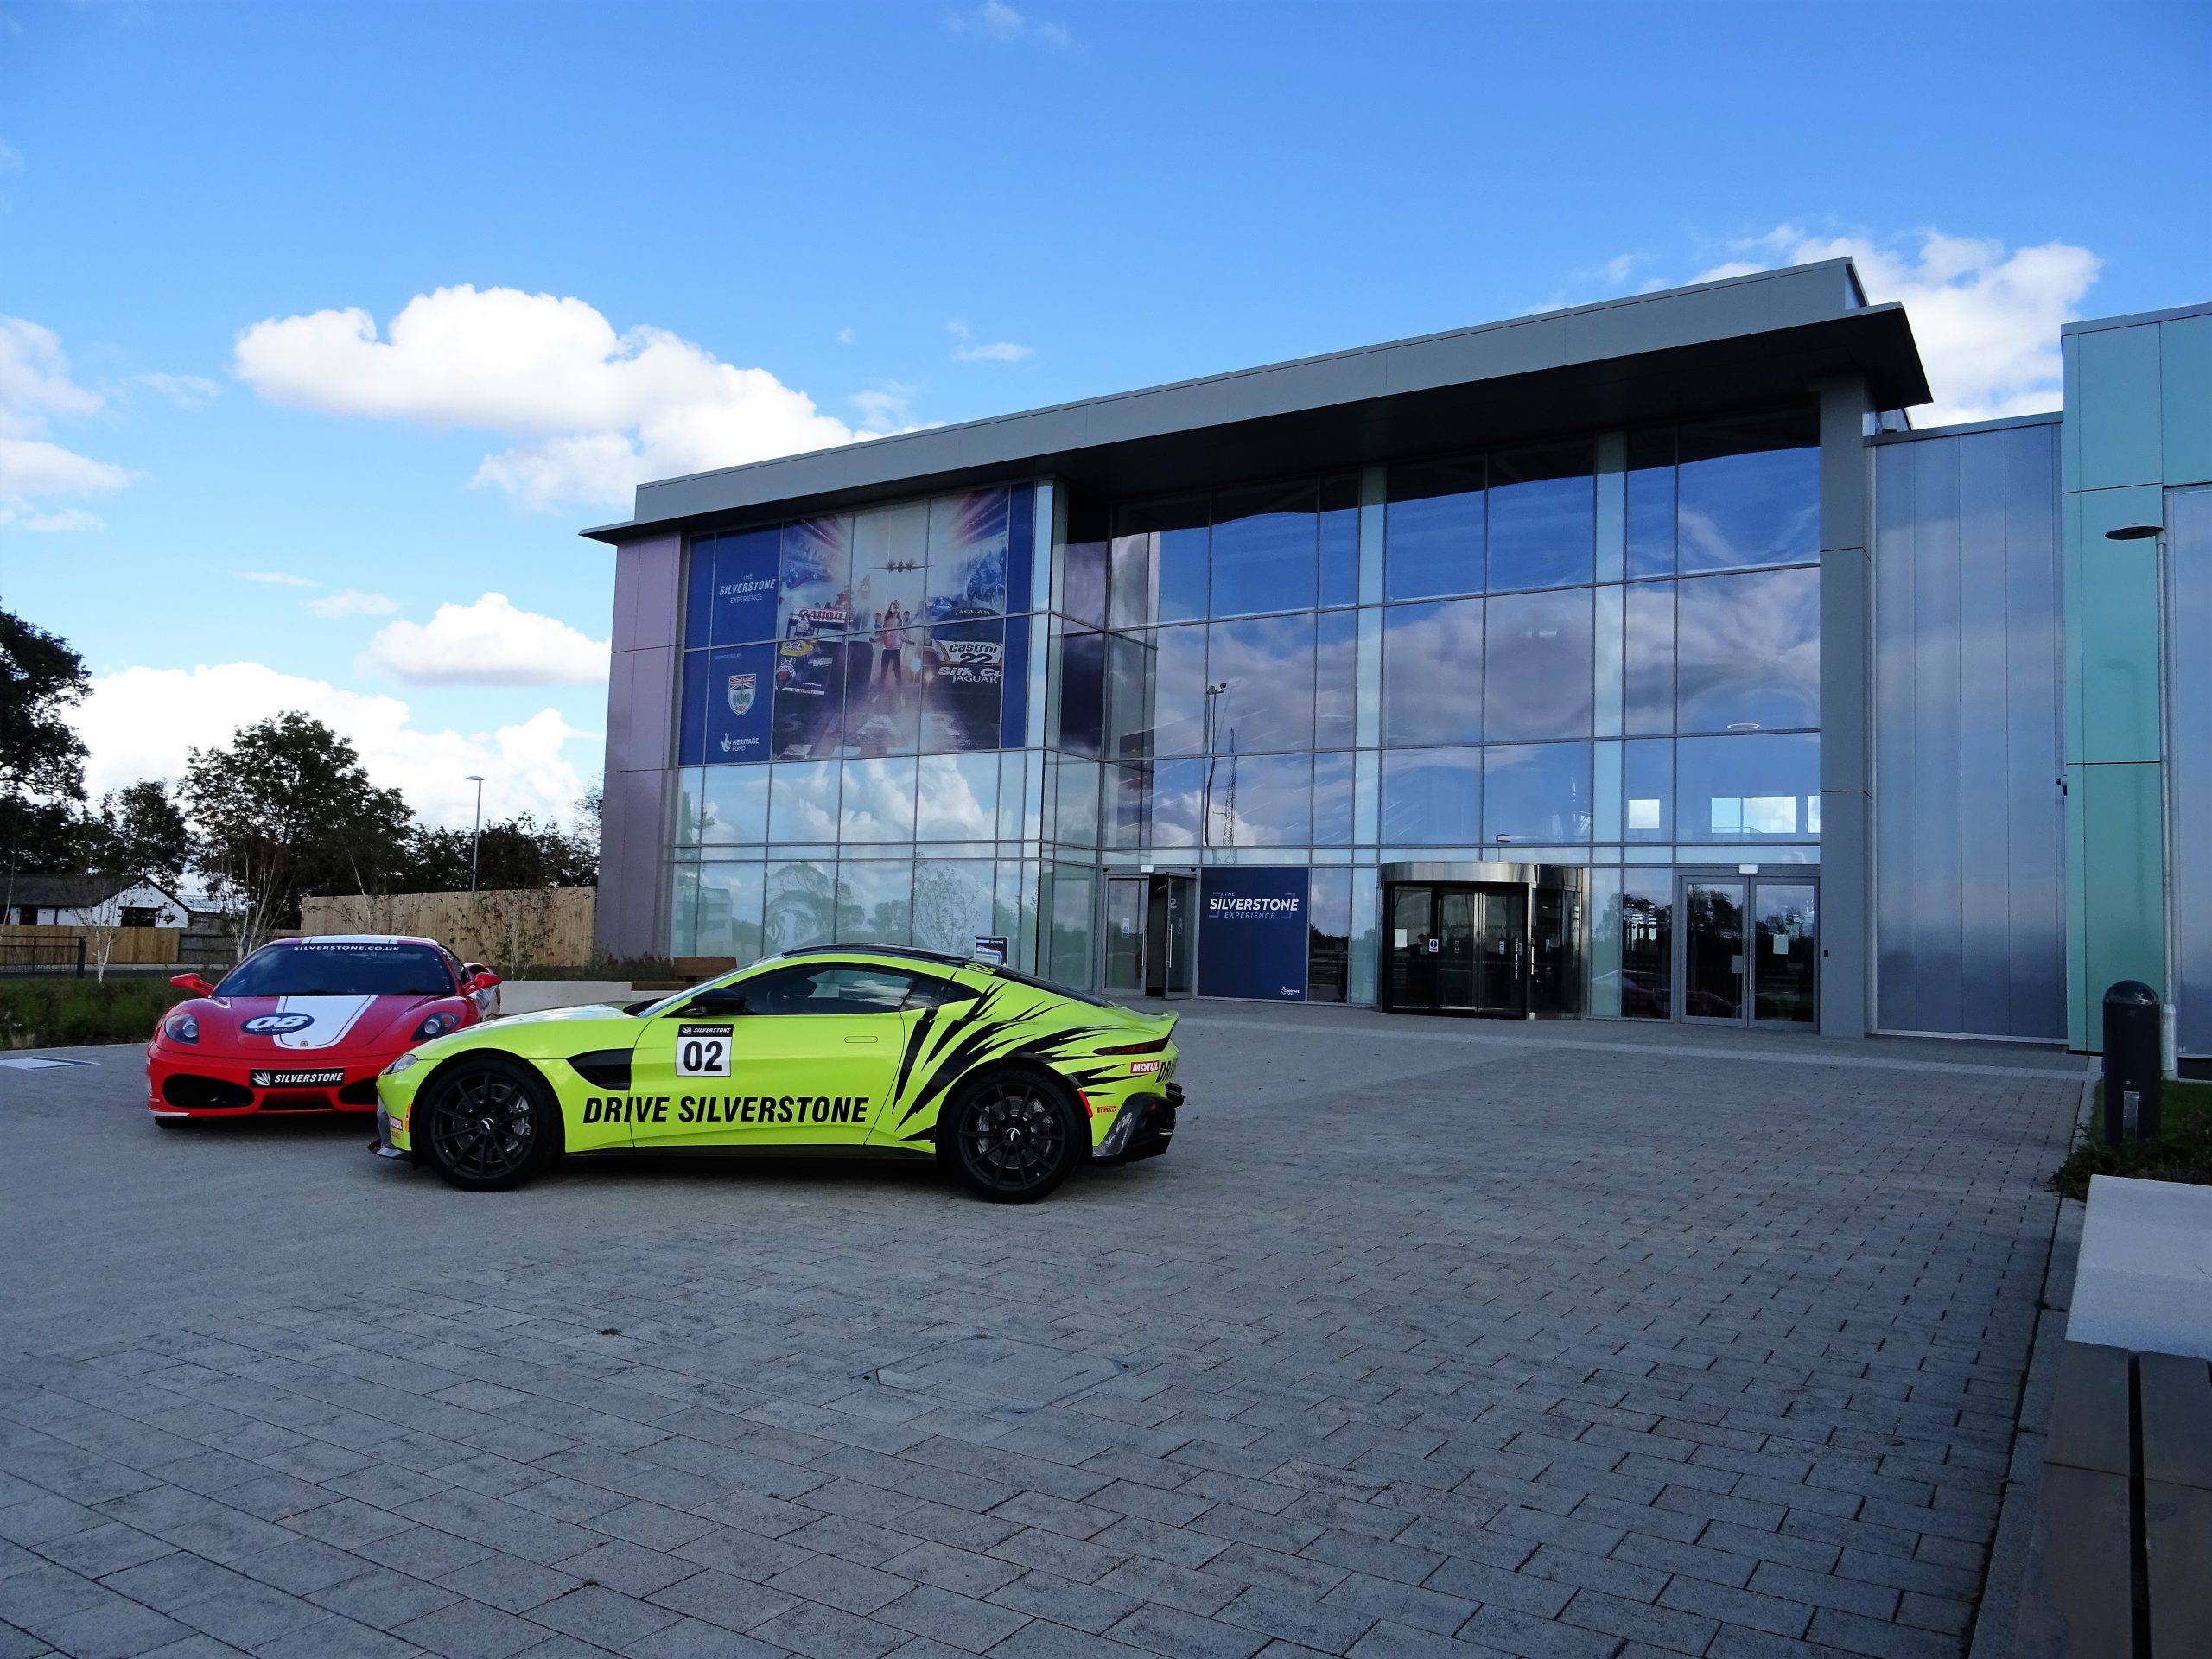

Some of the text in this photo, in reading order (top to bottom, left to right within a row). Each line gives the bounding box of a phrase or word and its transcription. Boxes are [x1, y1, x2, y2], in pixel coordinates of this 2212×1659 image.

[719, 579, 776, 596] SILVERSTONE
[730, 593, 763, 604] EXPERIENCE
[798, 608, 844, 621] Canon
[949, 643, 997, 653] Castrol
[959, 652, 993, 666] 22
[938, 666, 975, 676] Silk
[952, 675, 997, 683] JAGUAR
[1209, 898, 1300, 912] SILVERSTONE
[245, 1015, 309, 1029] 08
[683, 1040, 723, 1072] 02
[1132, 1061, 1158, 1072] MOTUL
[274, 1072, 344, 1084] SILVERSTONE
[582, 1096, 869, 1123] DRIVE SILVERSTONE
